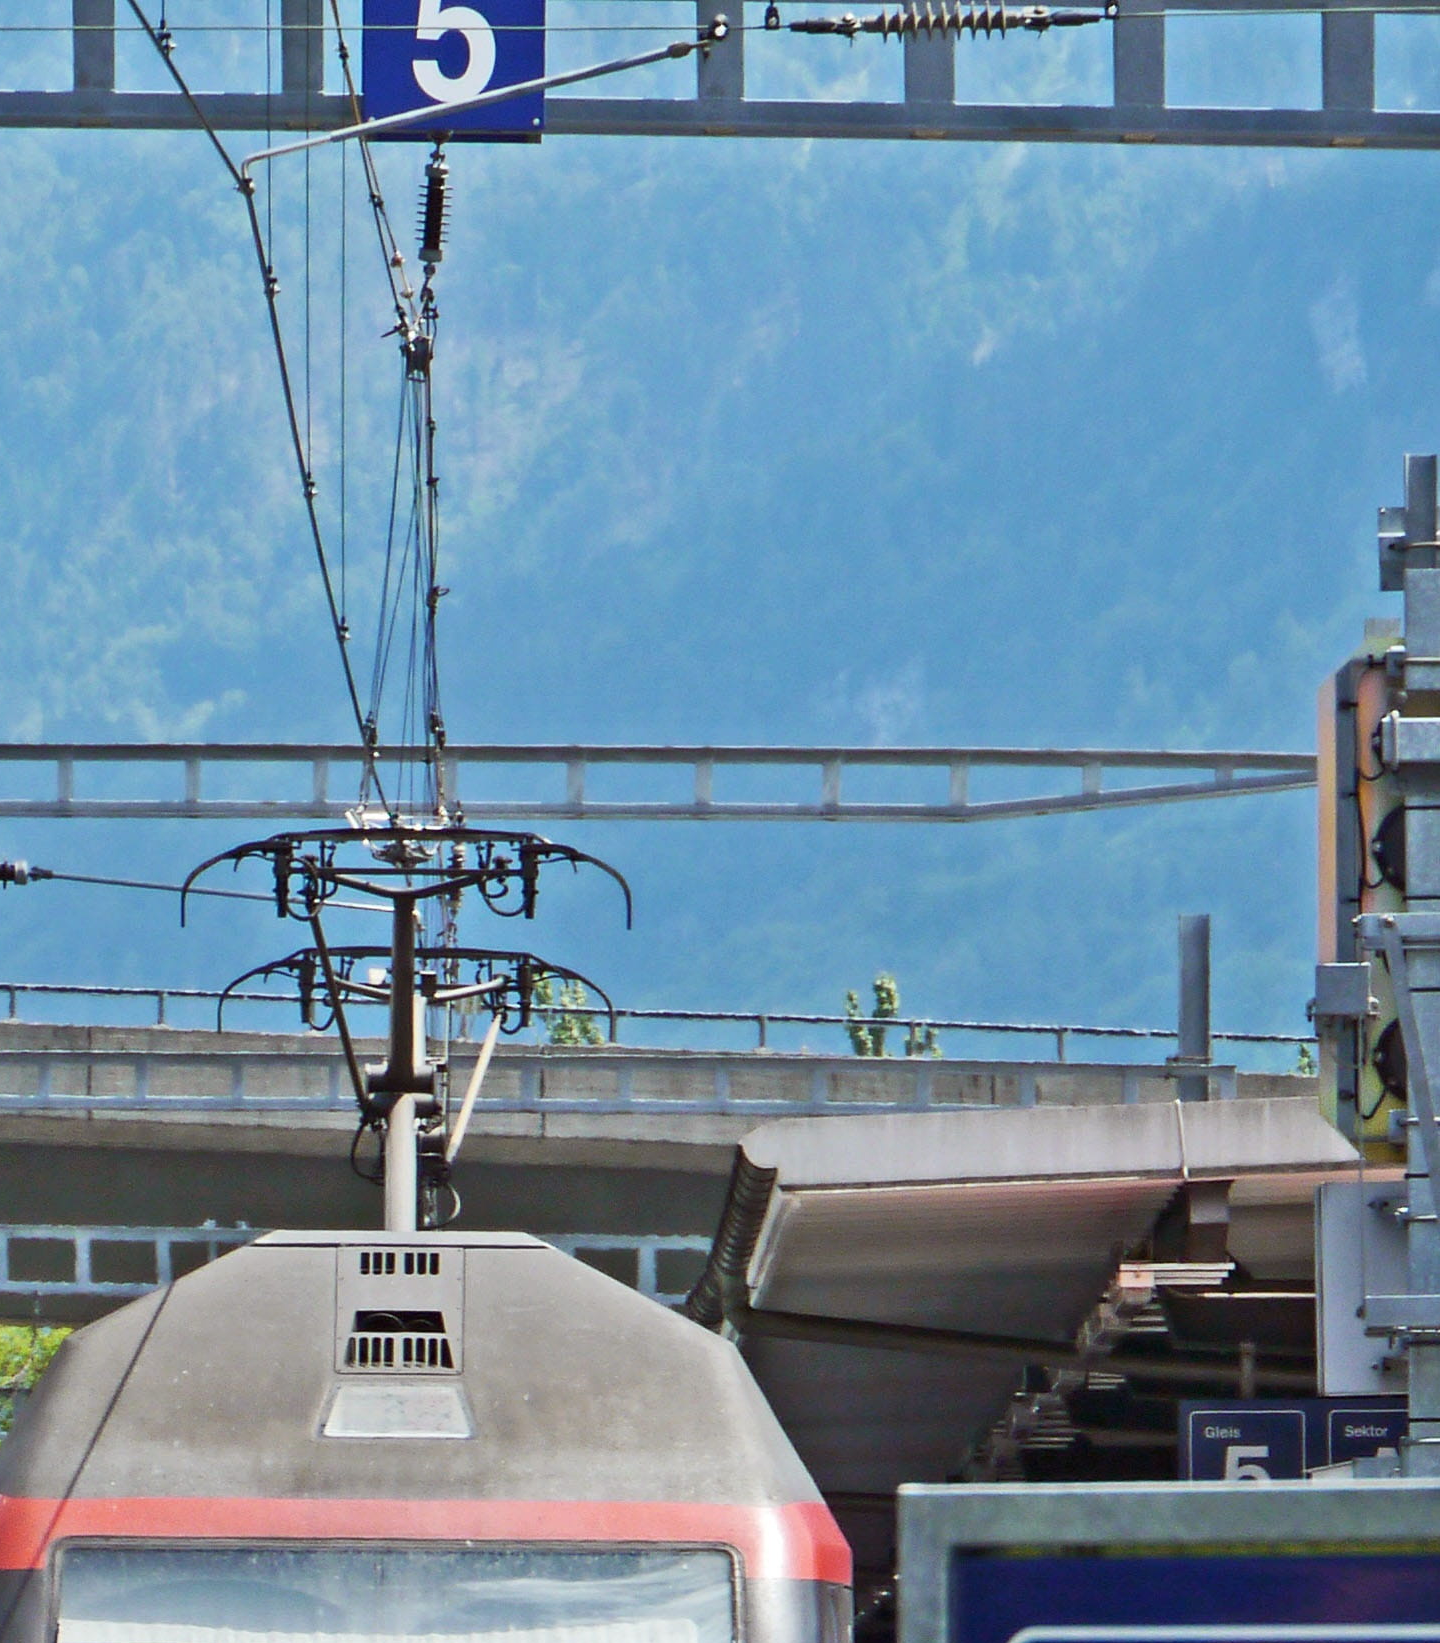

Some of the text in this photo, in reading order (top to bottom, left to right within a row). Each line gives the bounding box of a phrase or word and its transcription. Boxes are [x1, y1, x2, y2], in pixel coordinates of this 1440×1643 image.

[412, 0, 496, 103] 5
[1204, 1425, 1241, 1440] Gleis
[1344, 1424, 1389, 1438] Sektor
[1224, 1445, 1271, 1480] 5
